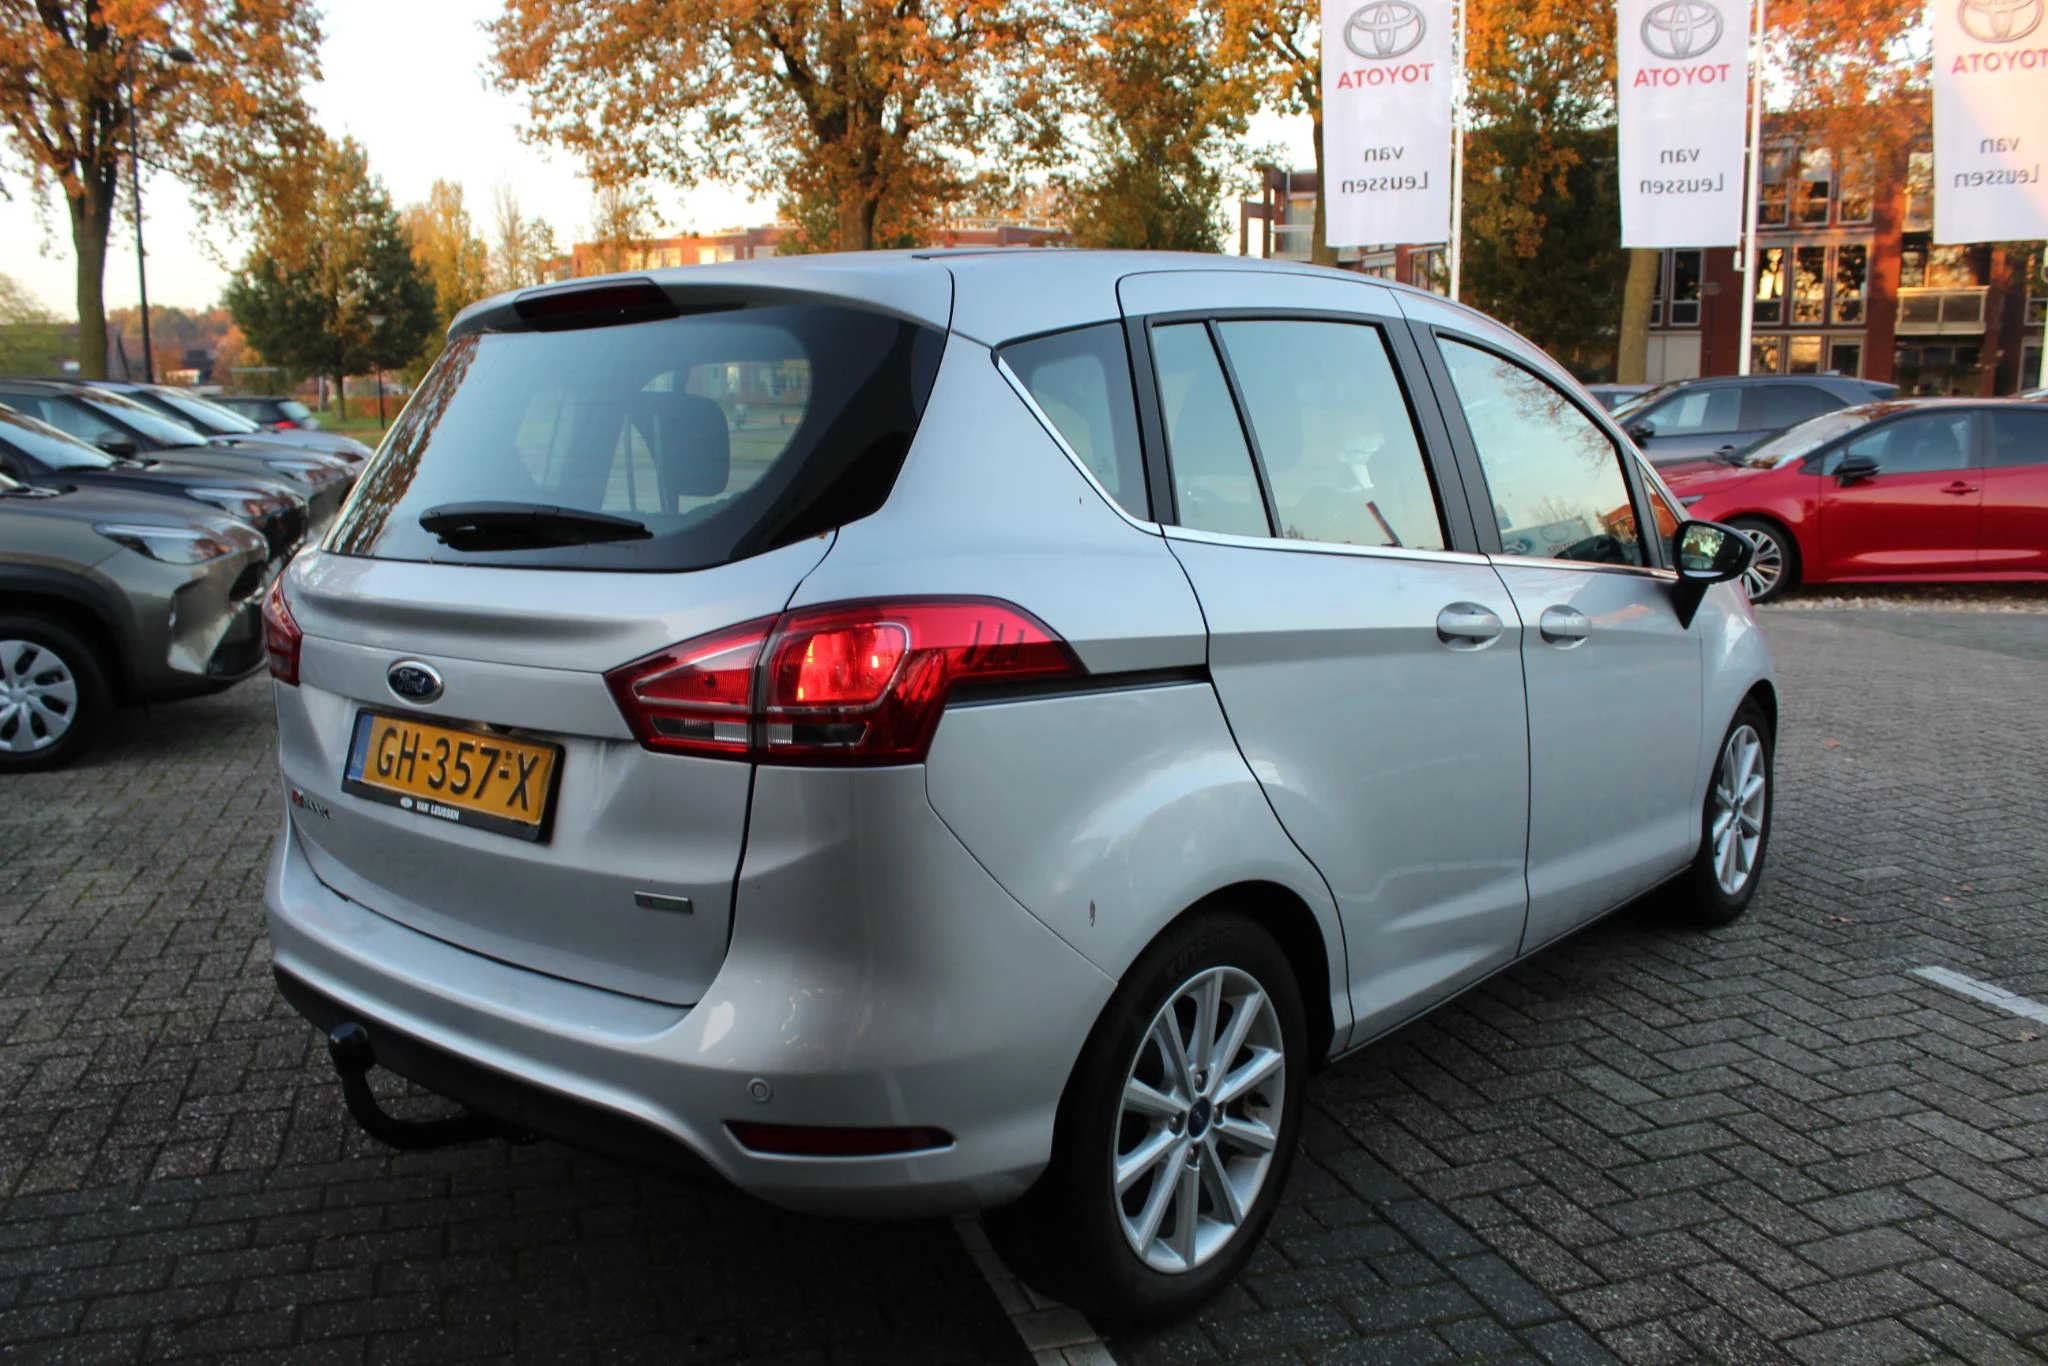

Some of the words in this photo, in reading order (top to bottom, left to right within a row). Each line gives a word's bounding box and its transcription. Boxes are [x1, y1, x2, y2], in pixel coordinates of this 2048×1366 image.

[376, 726, 540, 812] GH-357-X
[416, 800, 430, 813] VAN
[430, 804, 460, 820] LEUSSEN
